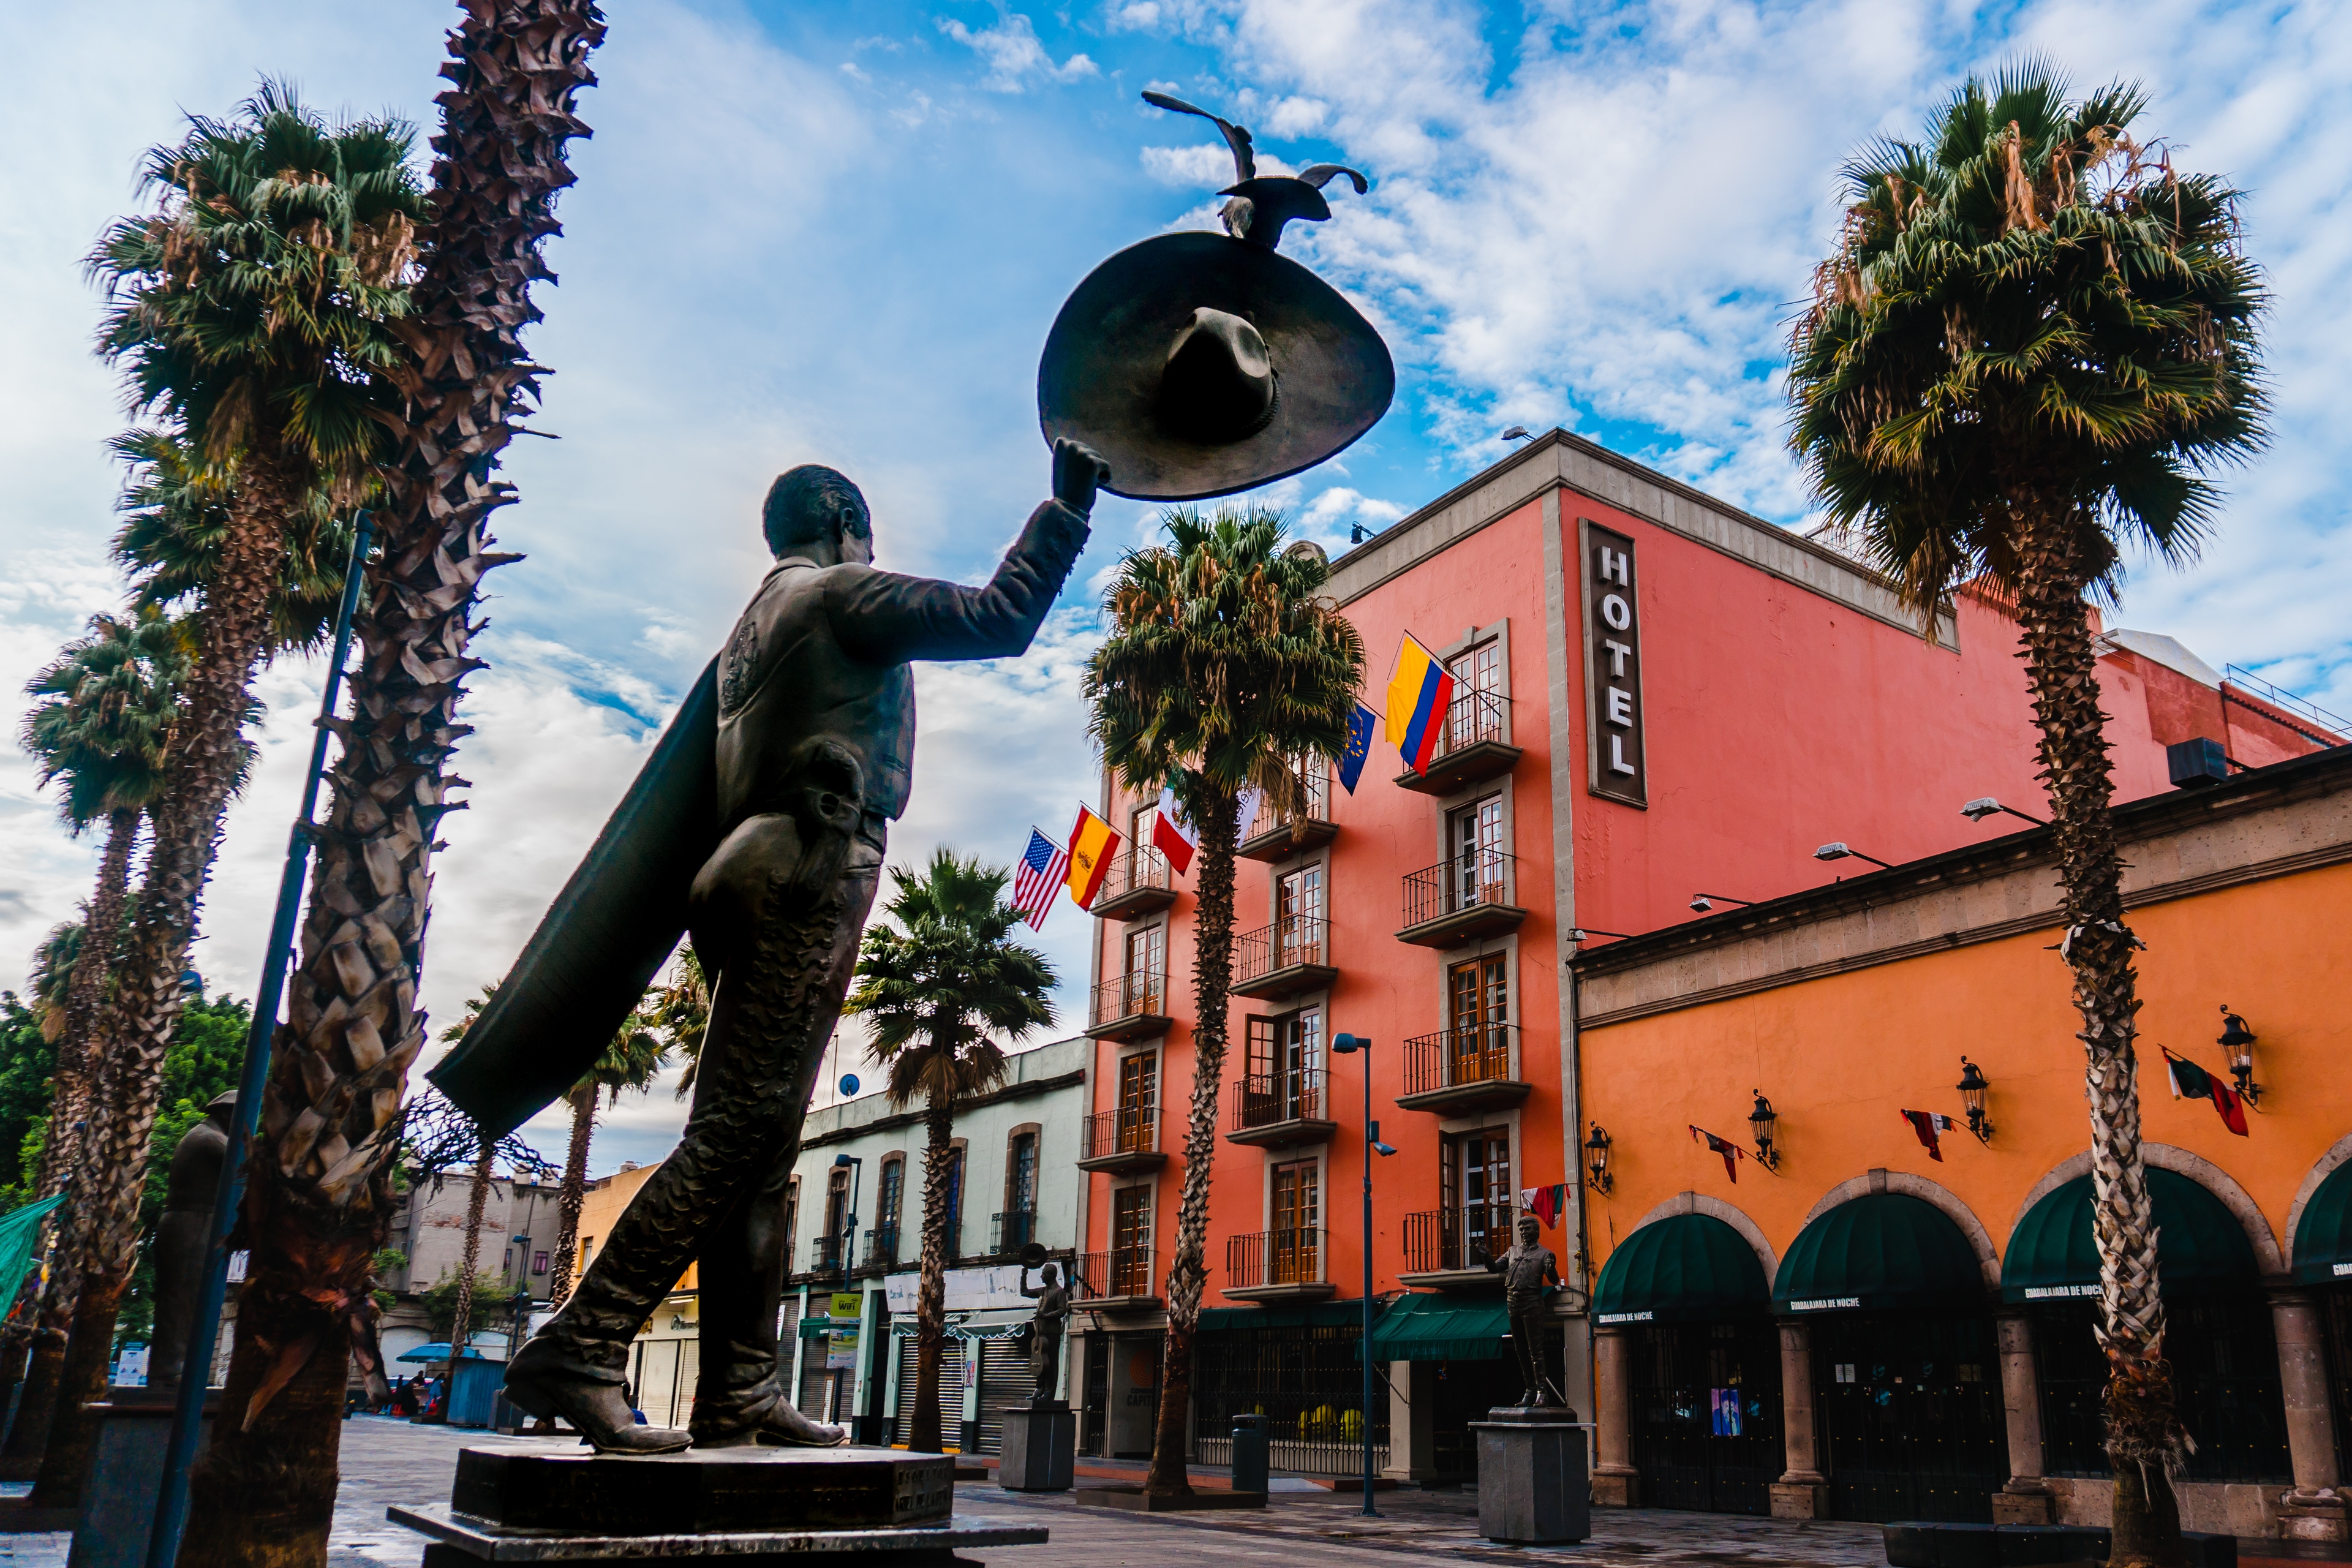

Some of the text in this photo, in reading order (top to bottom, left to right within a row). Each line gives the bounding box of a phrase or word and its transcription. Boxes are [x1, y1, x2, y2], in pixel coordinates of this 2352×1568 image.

[1597, 545, 1634, 777] HOTEL
[2025, 1284, 2103, 1298] GUADALAJARA DE NOCH
[1790, 1298, 1860, 1310] GUADALAJARA DE NOCHE
[1634, 1311, 1653, 1320] NOCHE
[1127, 1395, 1154, 1406] CAPIT
